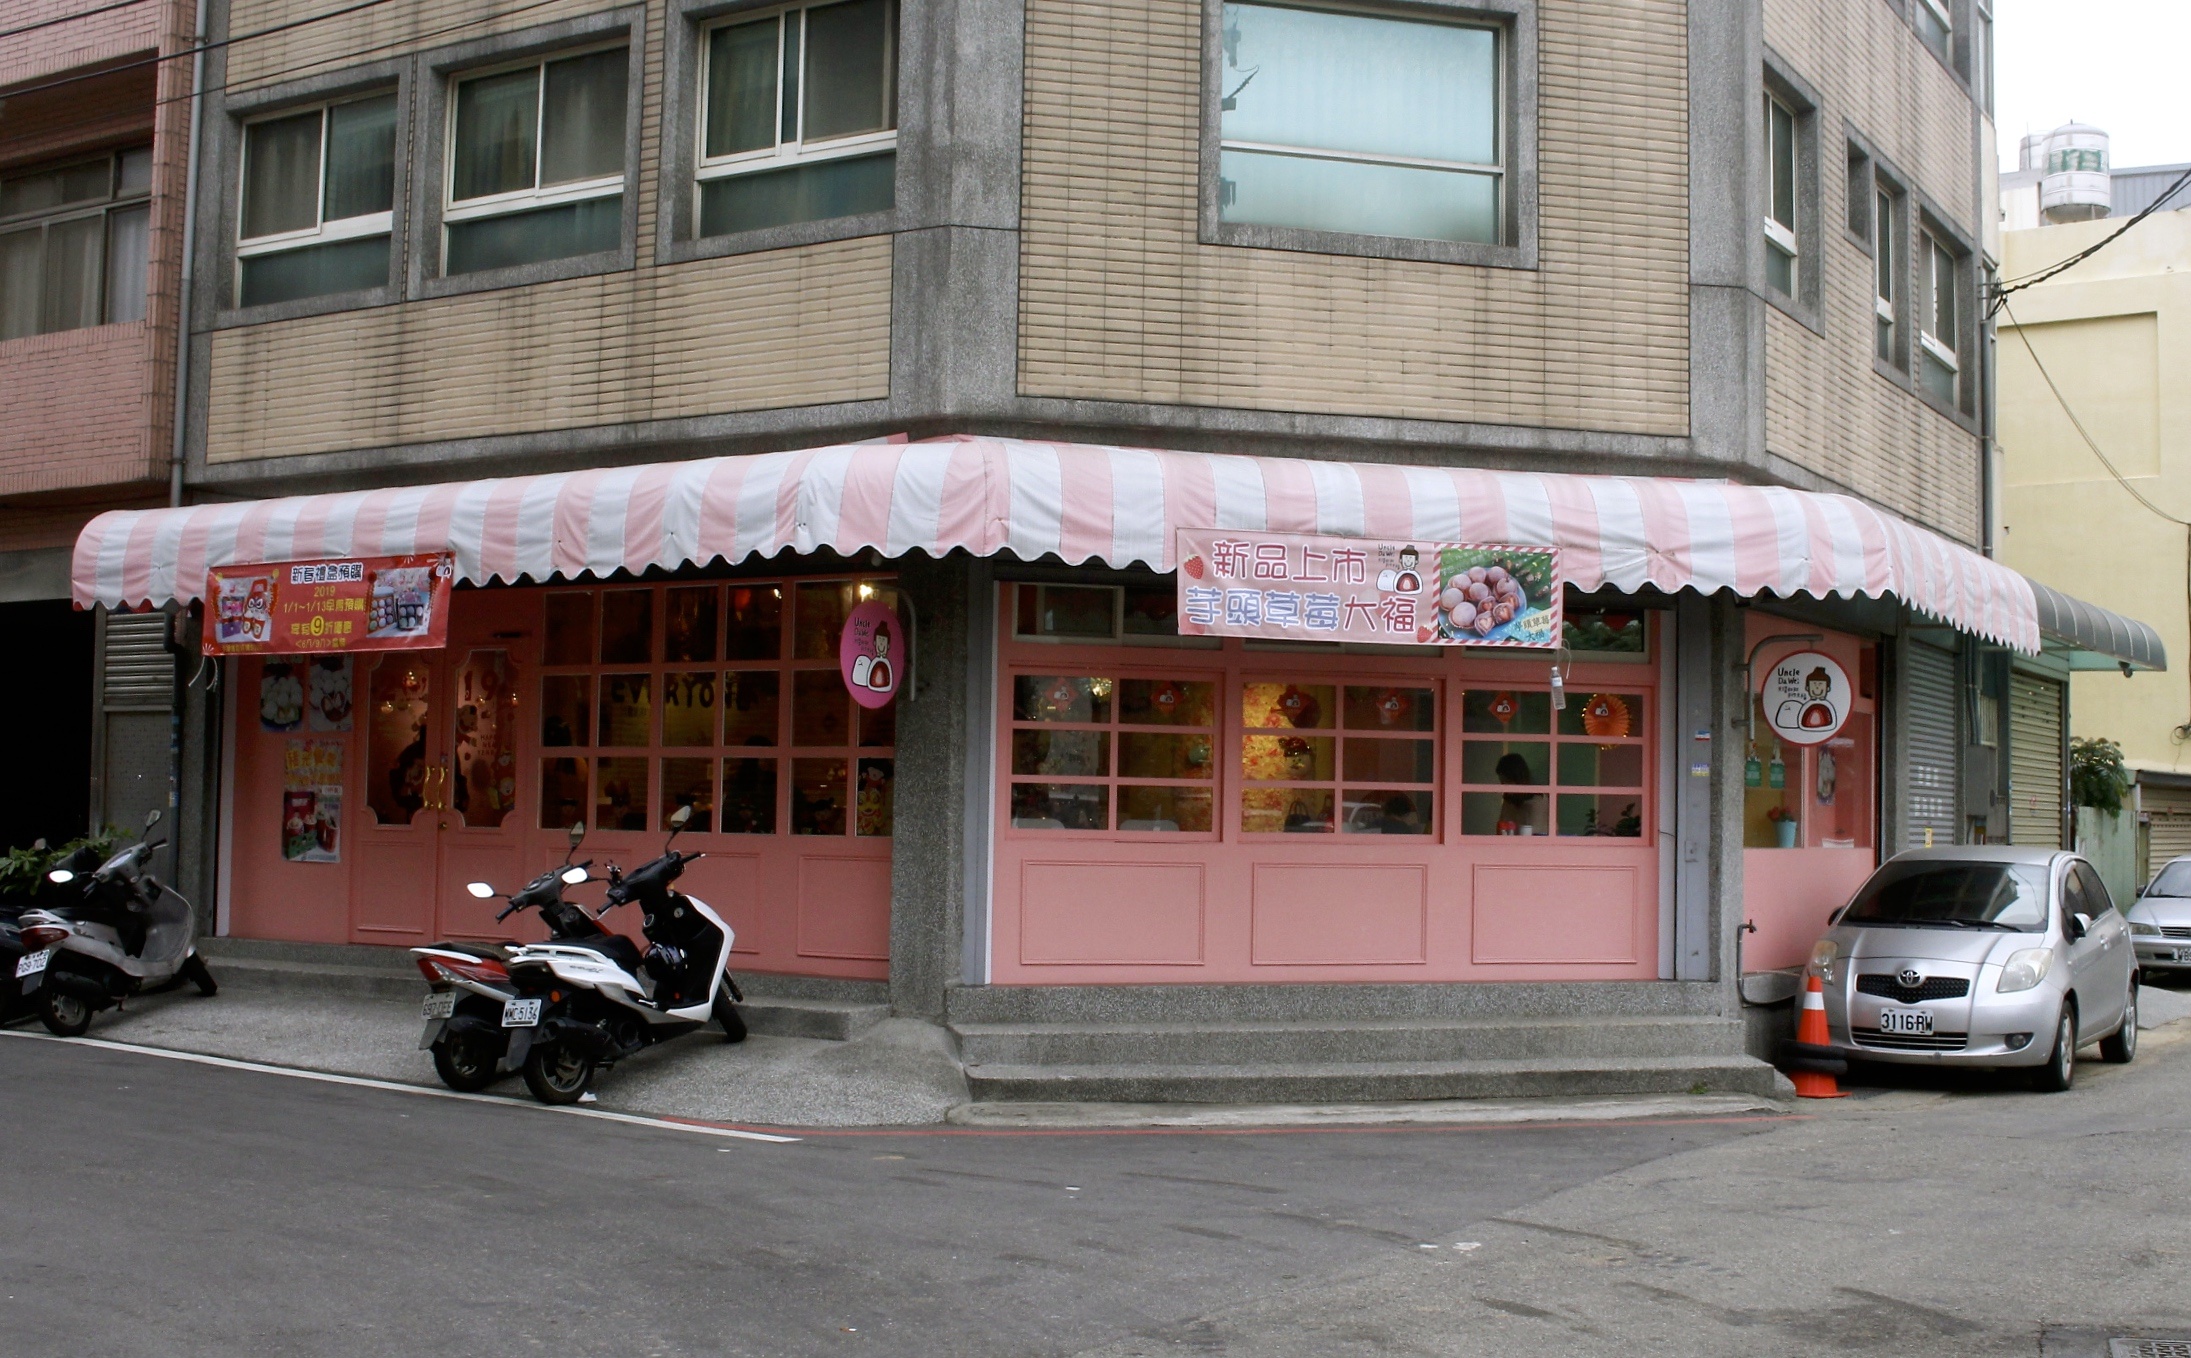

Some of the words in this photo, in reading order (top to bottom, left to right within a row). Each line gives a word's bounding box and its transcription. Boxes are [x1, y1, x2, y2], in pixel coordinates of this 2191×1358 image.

[1212, 539, 1368, 585] 新品上市
[314, 585, 336, 598] 2019
[1185, 586, 1417, 634] 芋頭草莓大福
[1777, 667, 1800, 677] Uncle
[1881, 1012, 1933, 1032] 3116-RW
